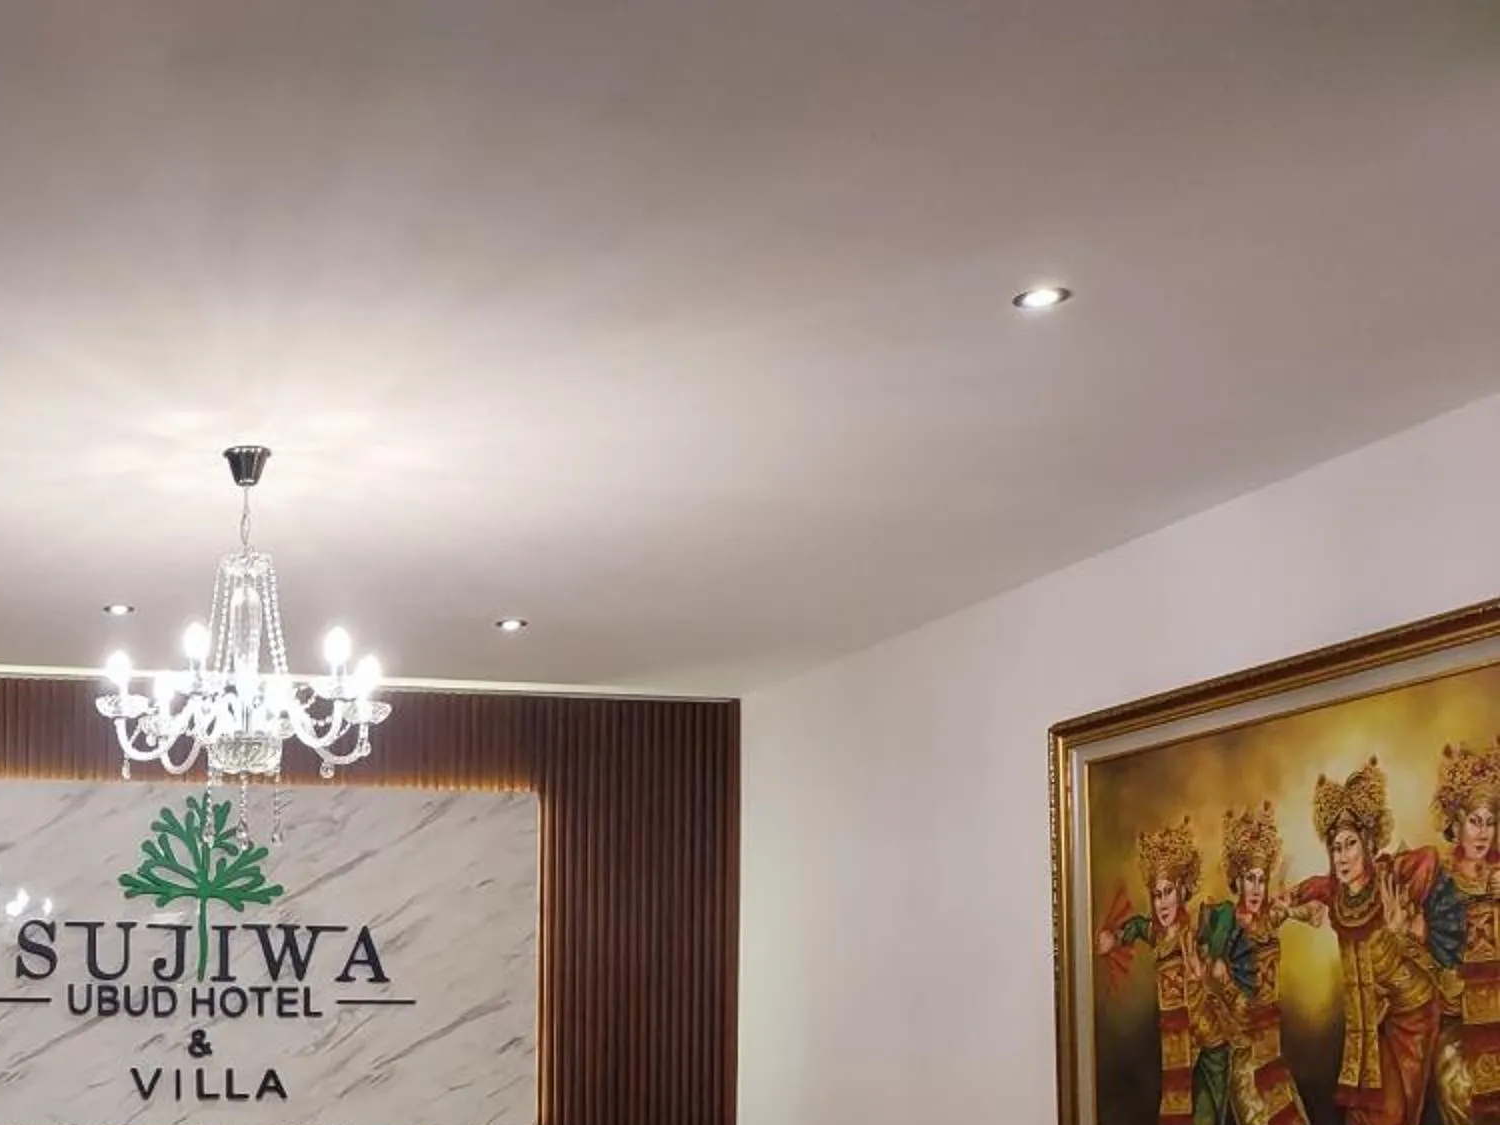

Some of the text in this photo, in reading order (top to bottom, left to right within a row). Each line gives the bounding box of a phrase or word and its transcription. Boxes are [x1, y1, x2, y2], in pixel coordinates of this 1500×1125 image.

[15, 919, 391, 984] SUJIWA
[67, 983, 323, 1019] UBUD HOTEL
[187, 1028, 213, 1059] &
[129, 1067, 288, 1102] VILLA
